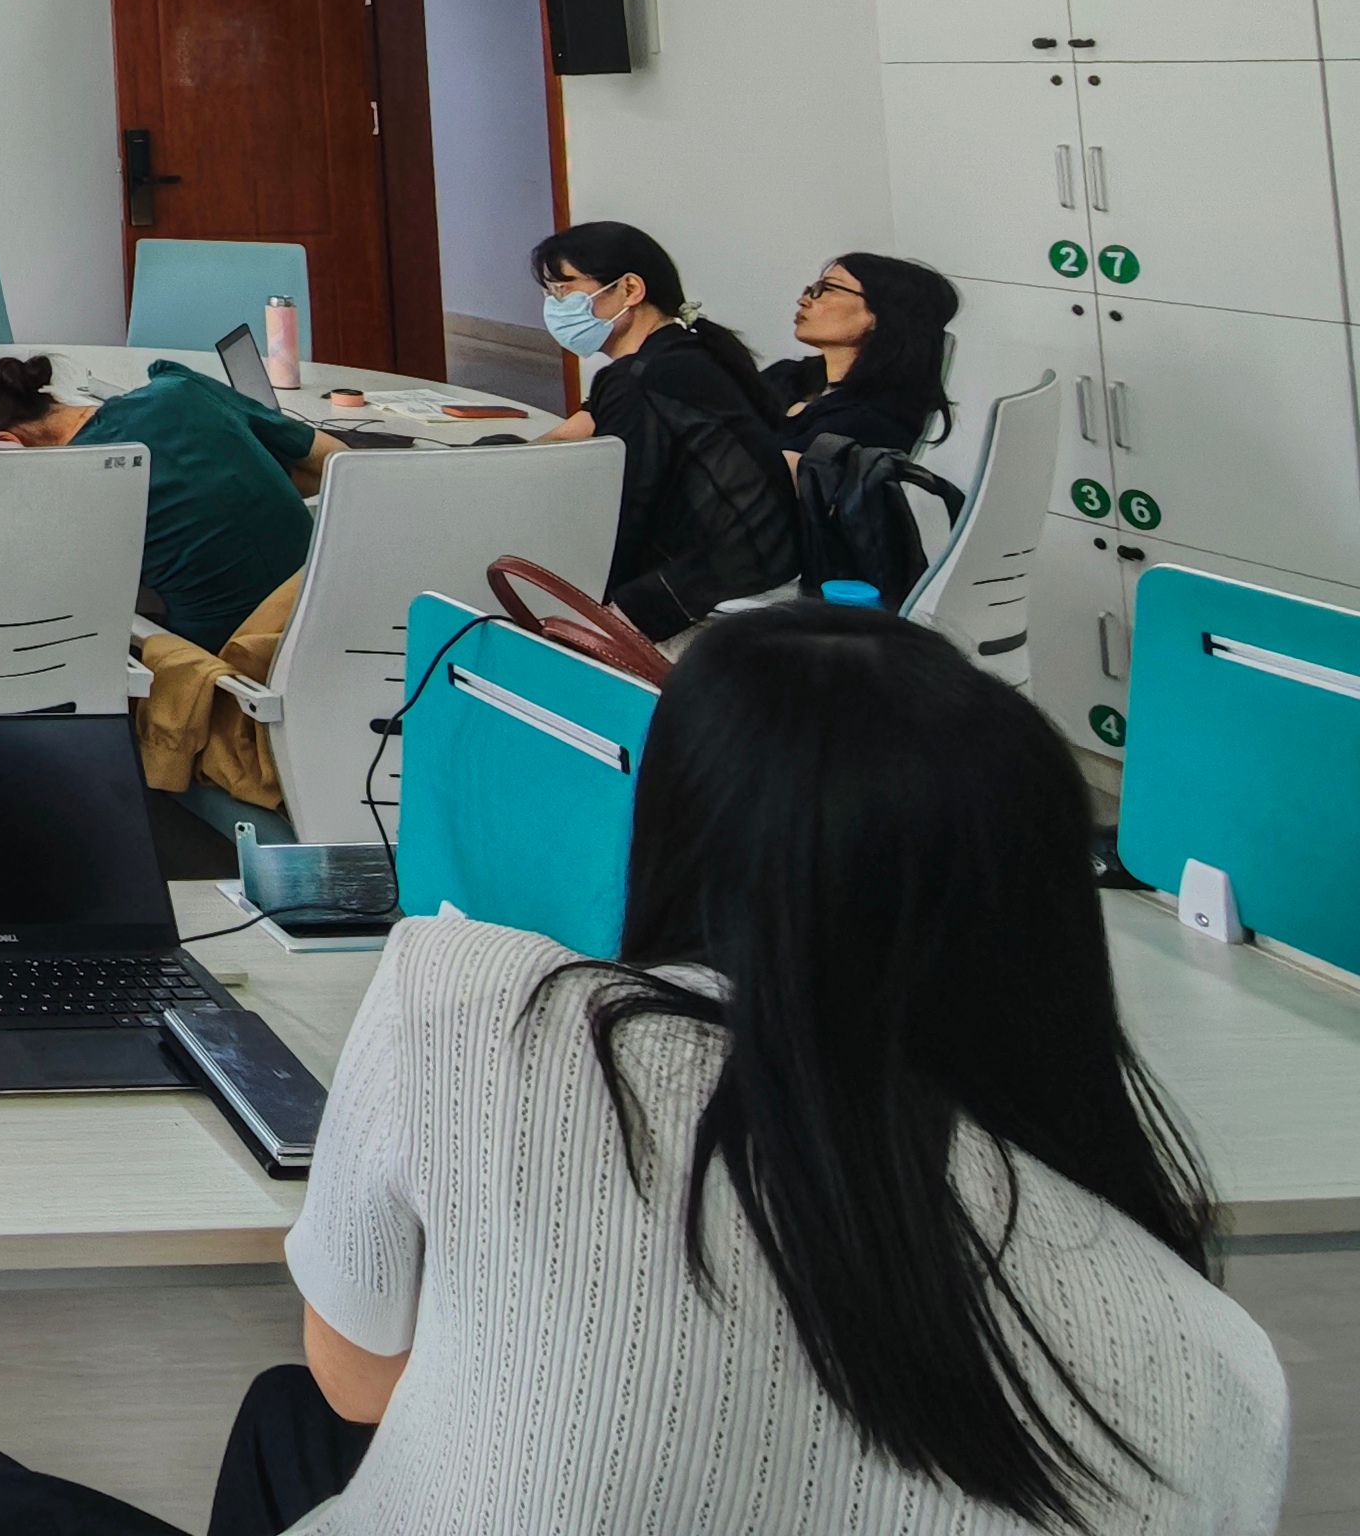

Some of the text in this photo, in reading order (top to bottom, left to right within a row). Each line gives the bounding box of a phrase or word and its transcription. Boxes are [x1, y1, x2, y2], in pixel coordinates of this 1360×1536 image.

[1060, 247, 1078, 271] 2
[1106, 252, 1125, 276] 7
[1081, 485, 1101, 510] 3
[1131, 497, 1150, 522] 6
[1100, 714, 1120, 740] 4
